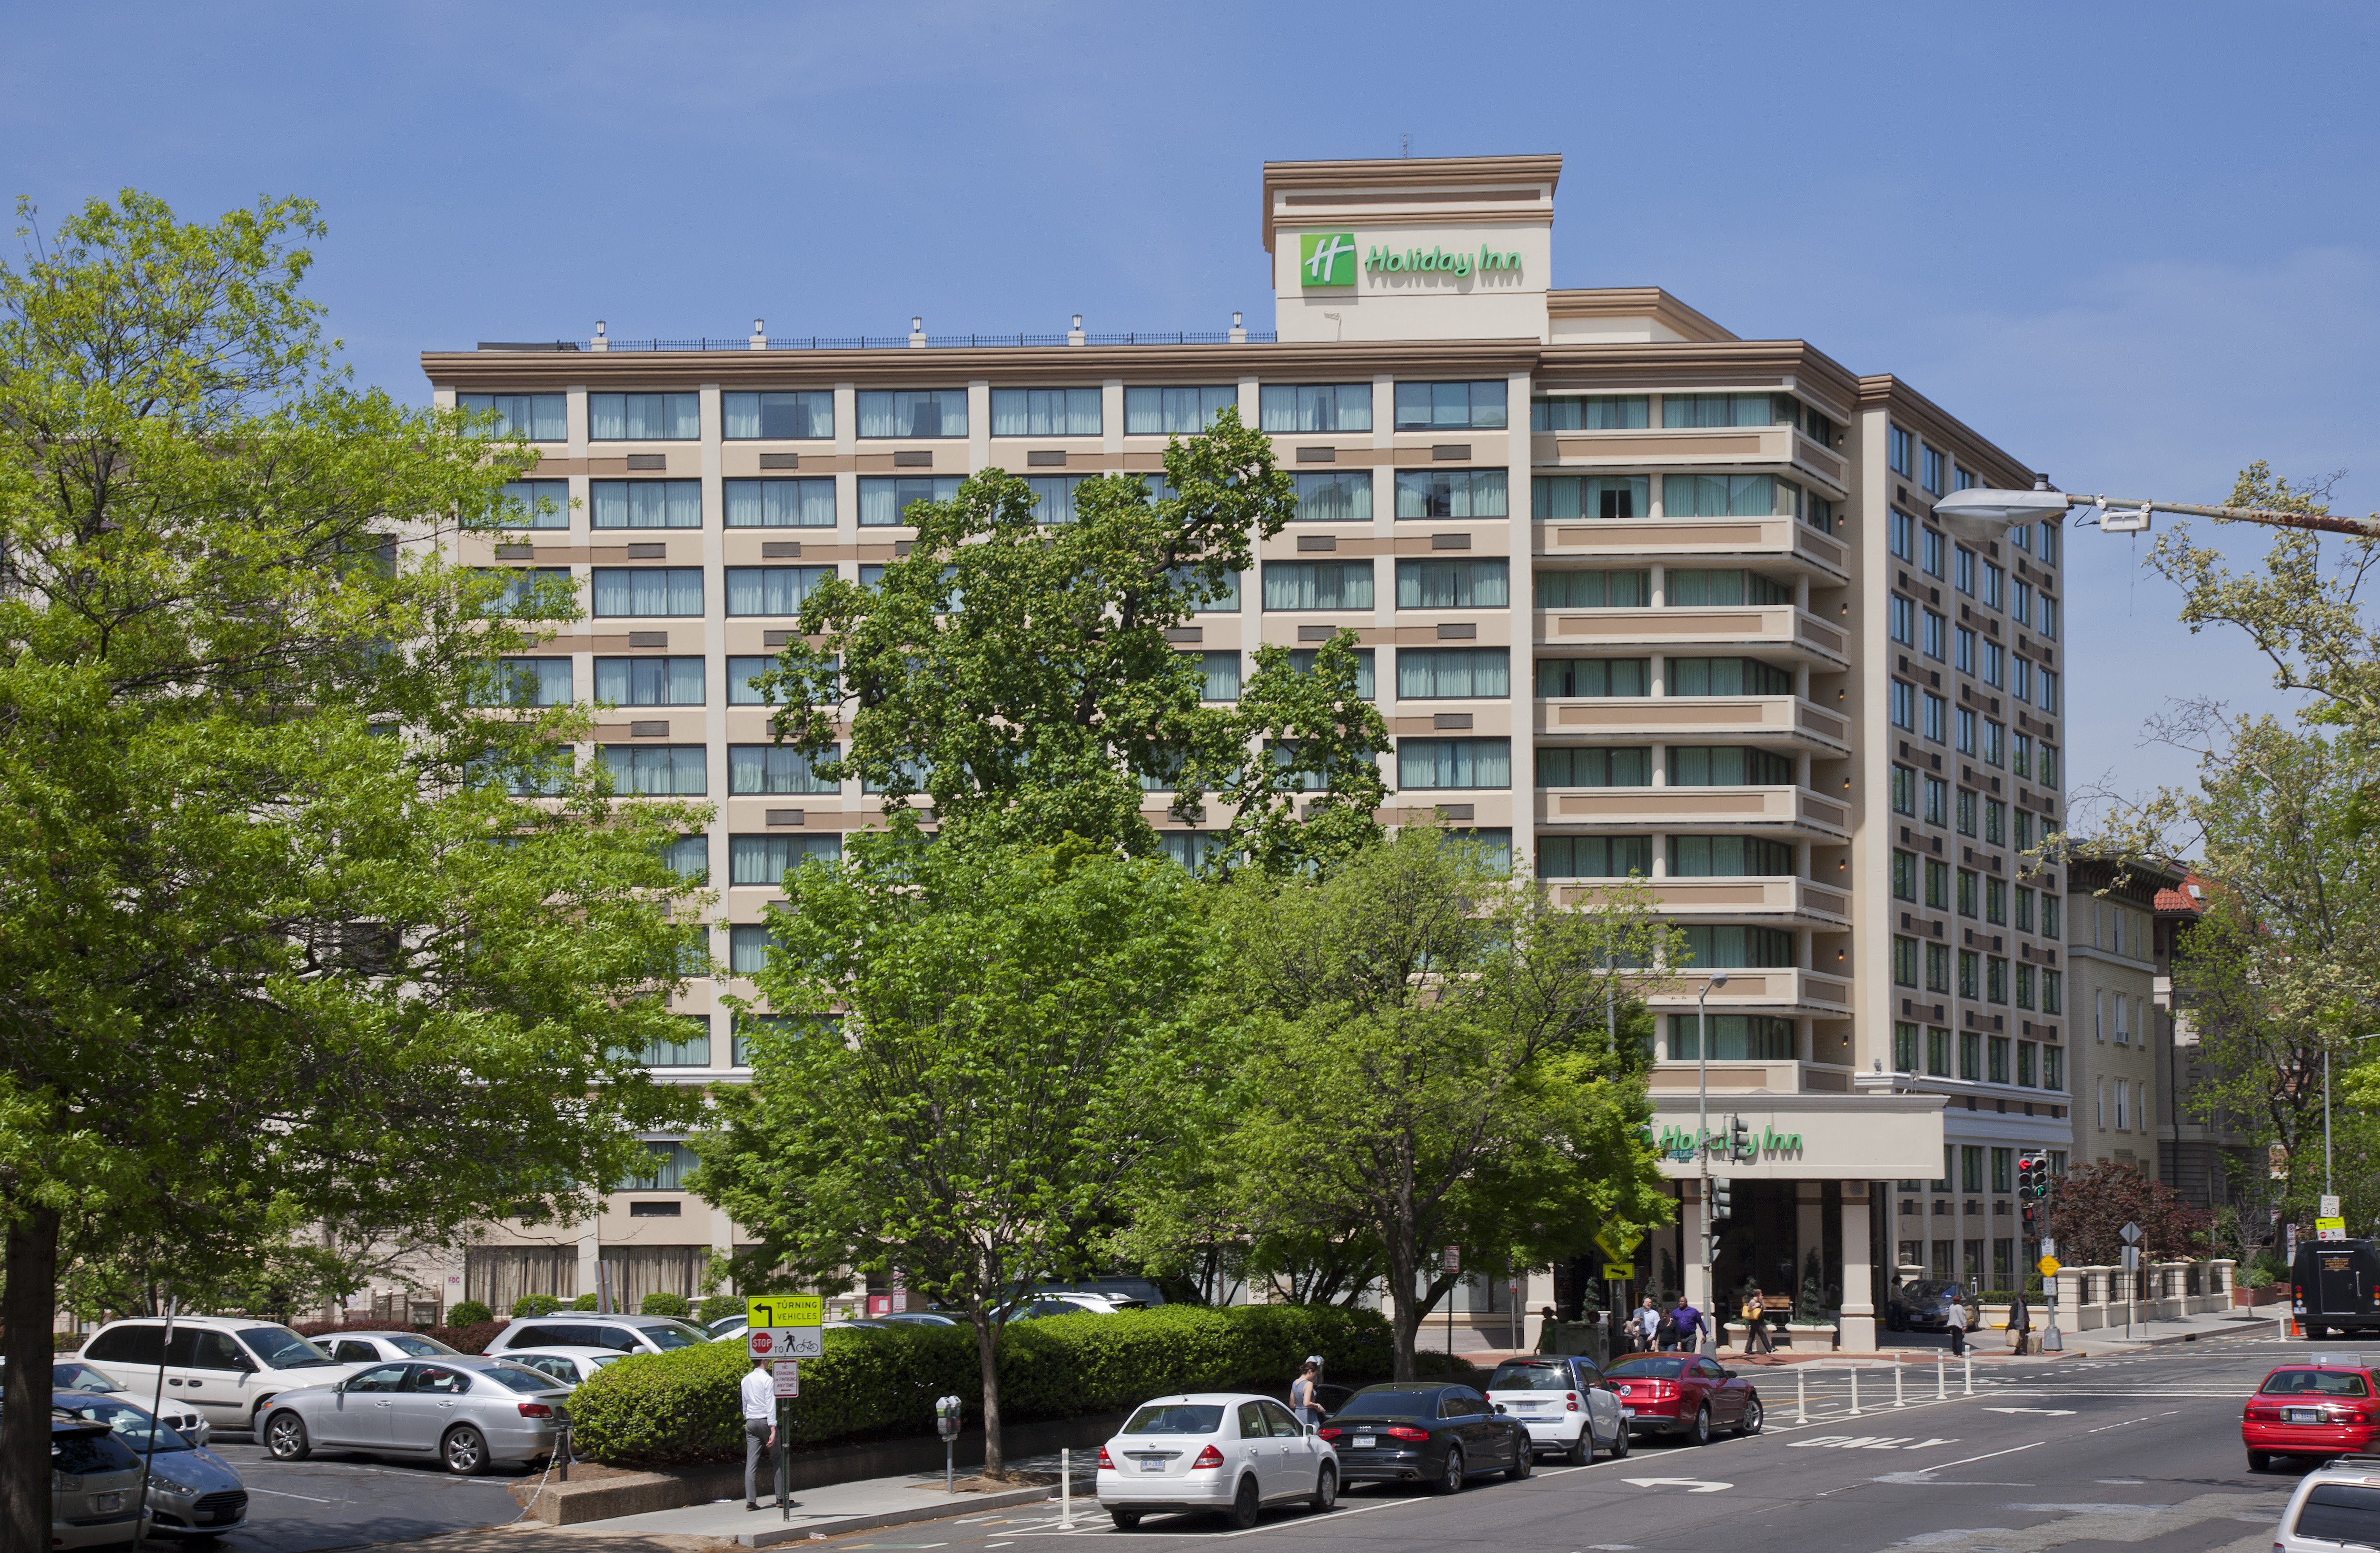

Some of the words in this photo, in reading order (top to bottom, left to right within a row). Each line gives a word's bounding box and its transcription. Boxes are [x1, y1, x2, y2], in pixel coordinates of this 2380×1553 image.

[1365, 245, 1473, 278] Holiday
[1478, 244, 1521, 271] Inn
[1763, 1125, 1802, 1150] Inn
[2323, 1207, 2336, 1215] 30
[753, 1338, 772, 1348] STOP
[1786, 1436, 1964, 1450] ONLY
